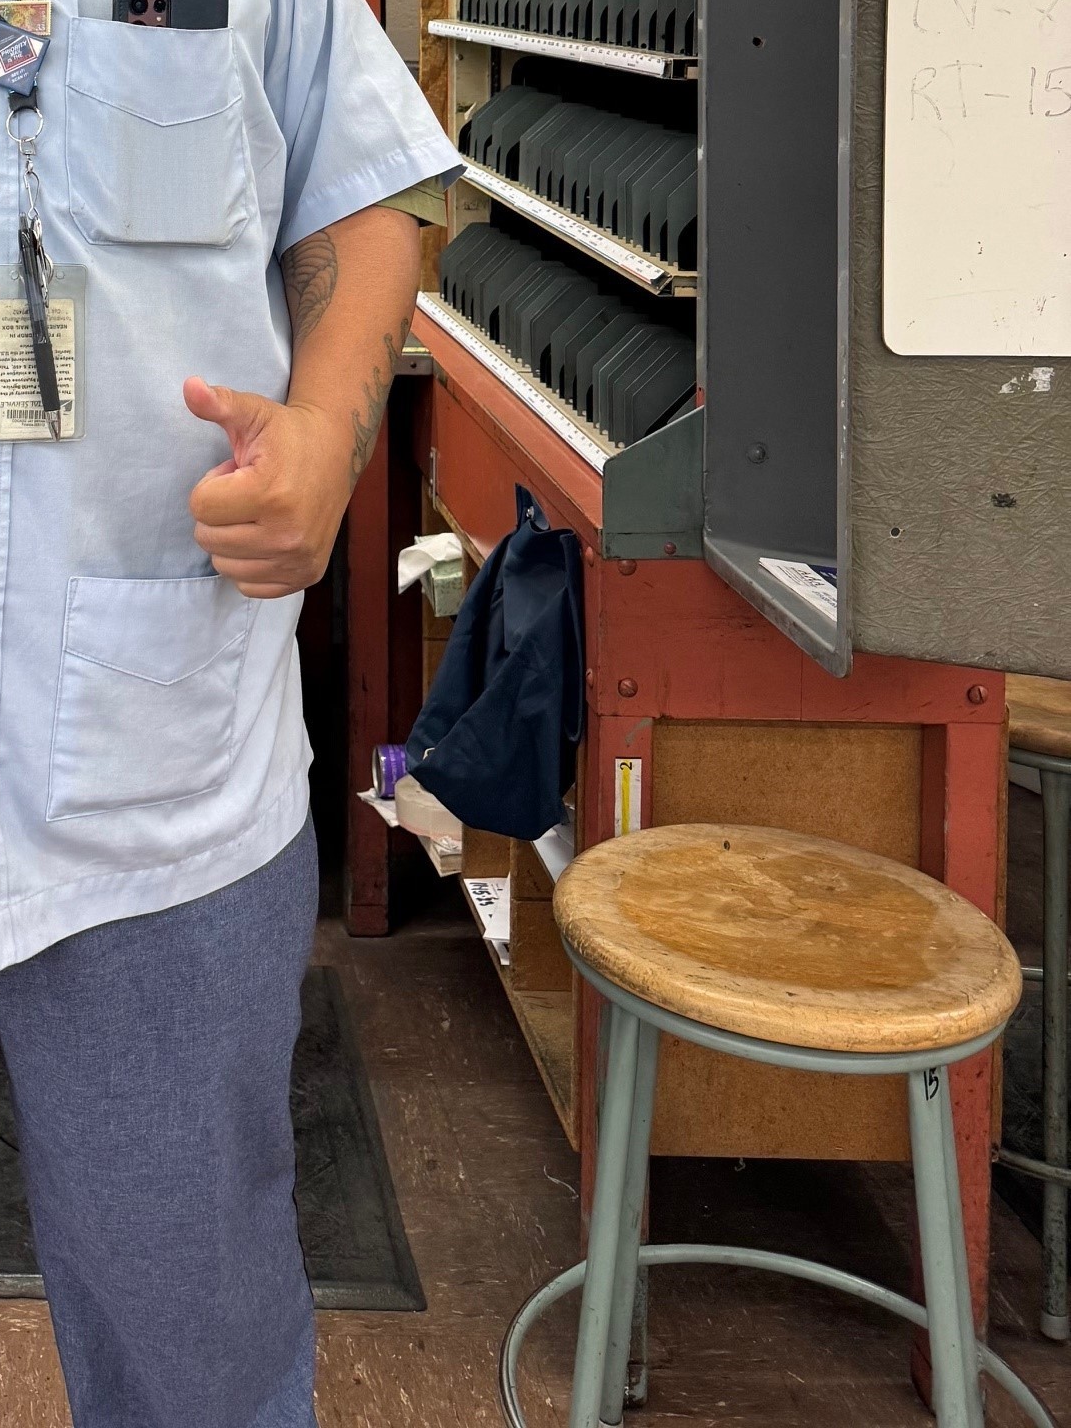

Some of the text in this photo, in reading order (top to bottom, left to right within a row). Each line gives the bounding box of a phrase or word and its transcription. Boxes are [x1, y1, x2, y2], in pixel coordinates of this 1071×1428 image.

[1, 40, 27, 56] PRIORITY
[619, 761, 633, 771] 2
[923, 1067, 939, 1101] 15
